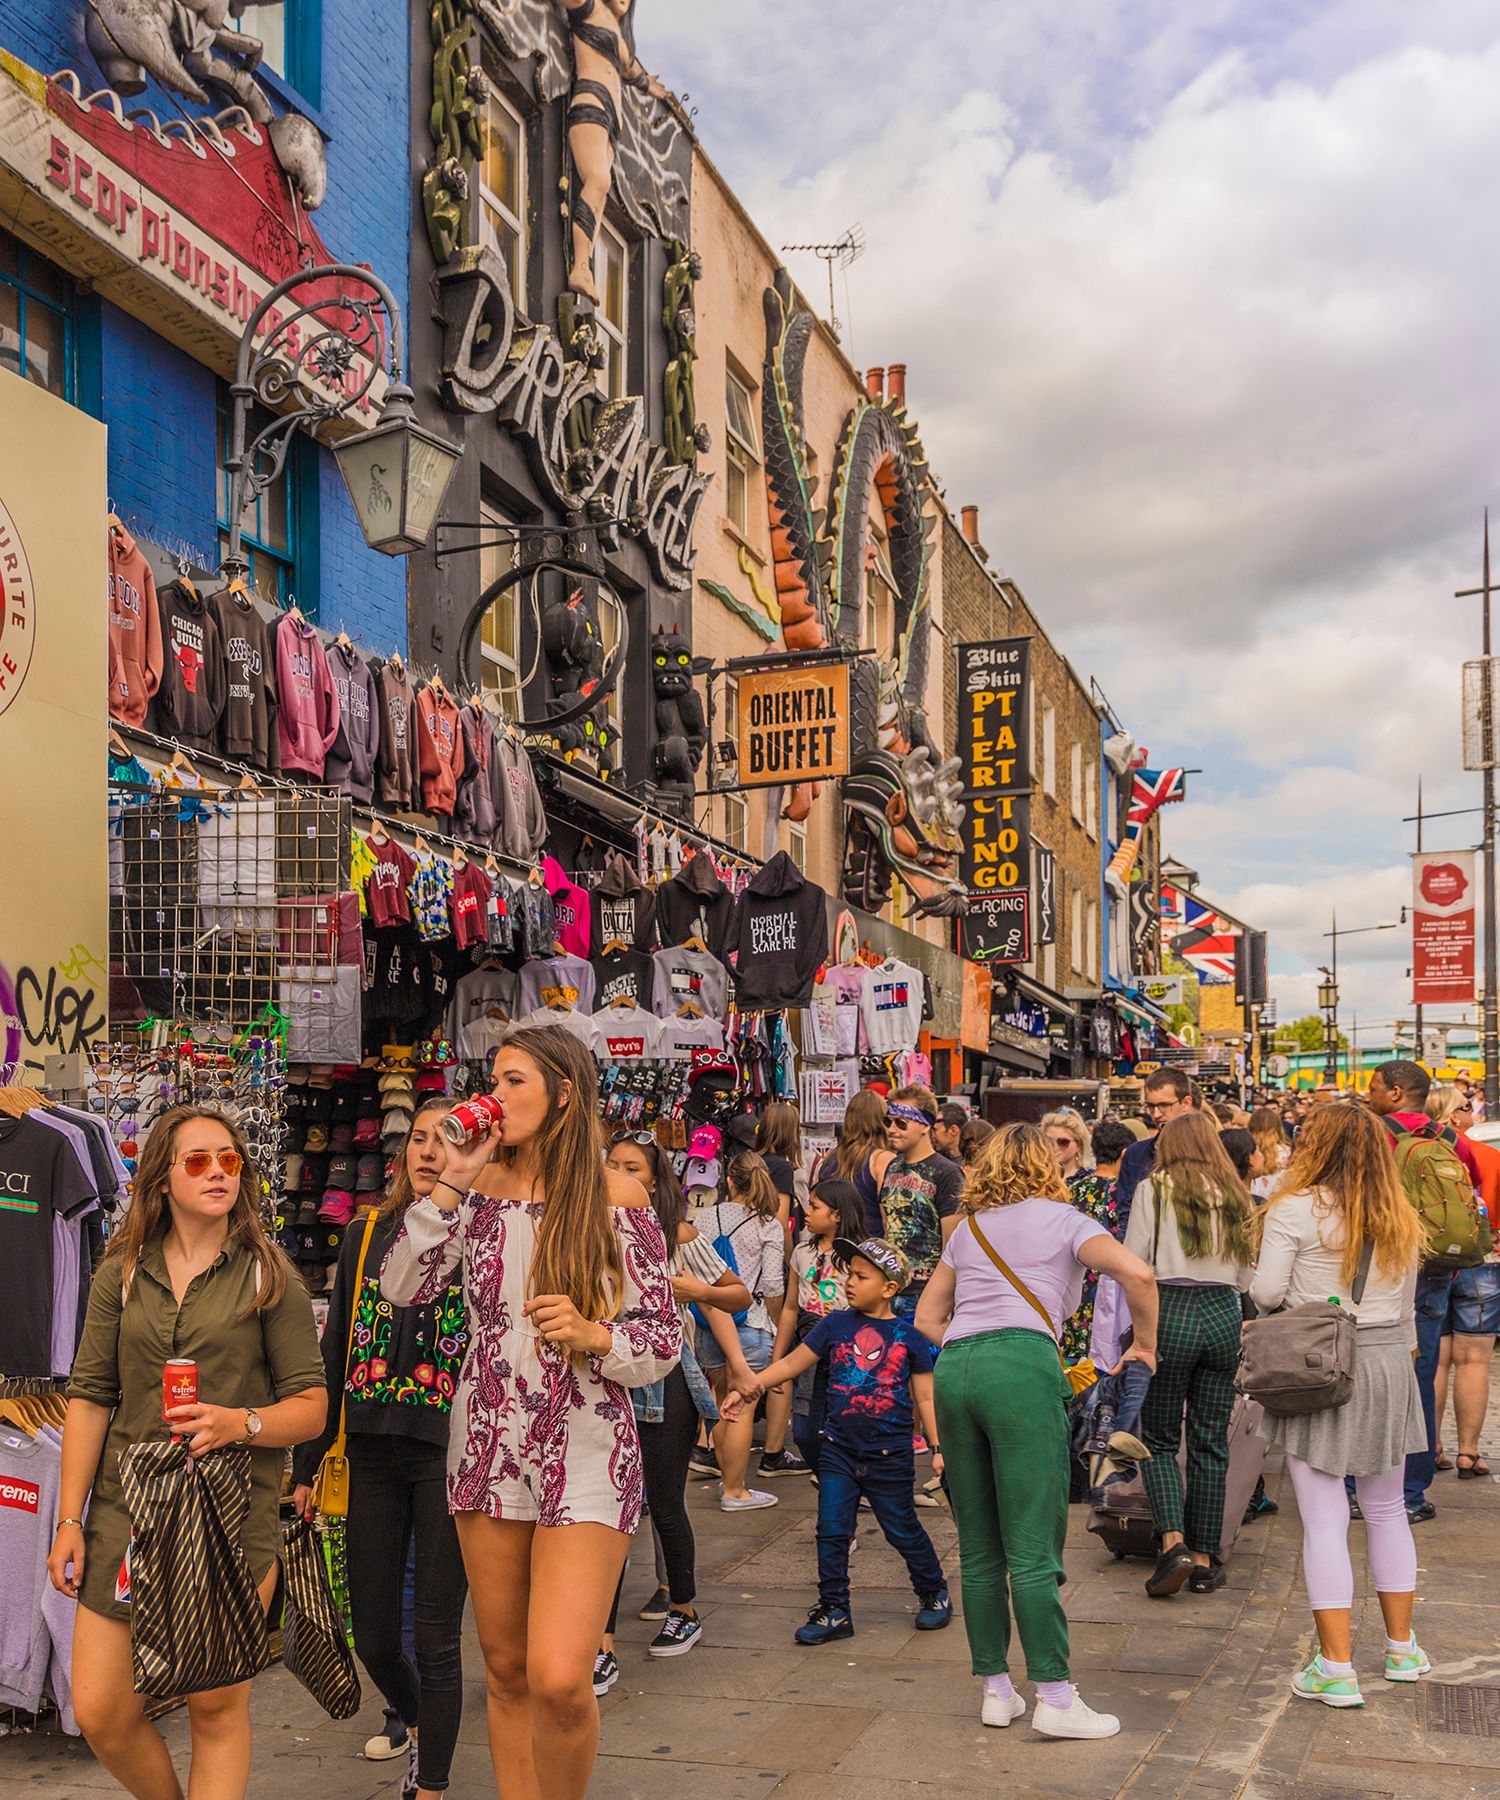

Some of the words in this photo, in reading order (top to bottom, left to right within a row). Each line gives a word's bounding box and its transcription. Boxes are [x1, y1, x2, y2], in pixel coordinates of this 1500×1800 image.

[176, 630, 203, 652] BULLS
[967, 648, 1020, 669] Blue
[967, 670, 1022, 693] Skin
[751, 686, 836, 727] ORIENTAL
[750, 724, 836, 773] BUFFET
[971, 691, 998, 888] PIERCING
[995, 690, 1019, 887] TATTOO
[554, 902, 575, 926] ORD
[966, 897, 1024, 916] ERCING
[750, 911, 797, 929] NORMAL
[987, 913, 998, 928] &
[752, 924, 796, 946] PEOPLE
[752, 941, 781, 954] SCARE
[783, 939, 796, 950] ME
[1136, 1063, 1158, 1072] ATM
[697, 1163, 707, 1174] 3
[695, 1193, 705, 1208] L
[875, 1250, 902, 1275] York
